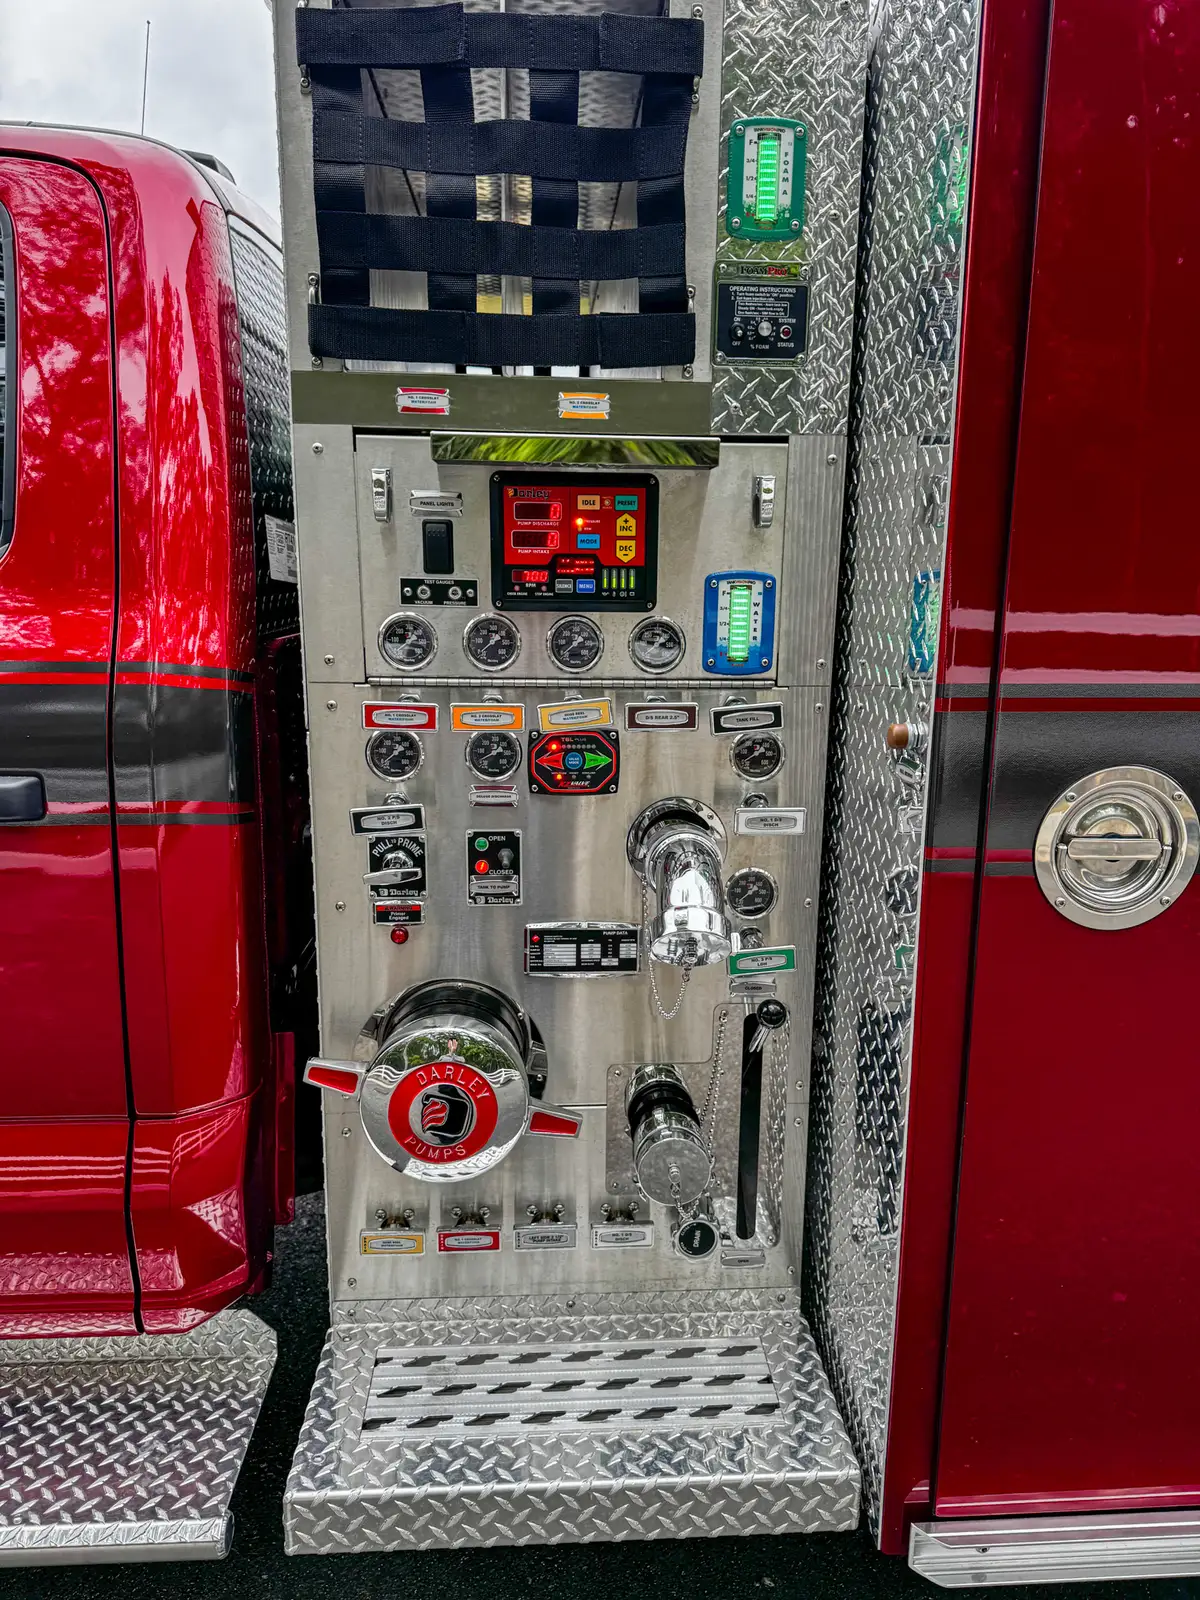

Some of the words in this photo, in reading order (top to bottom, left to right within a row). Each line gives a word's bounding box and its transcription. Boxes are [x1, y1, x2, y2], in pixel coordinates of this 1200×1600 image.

[782, 152, 790, 183] FOAM
[550, 503, 560, 519] 0
[547, 532, 557, 547] 0
[372, 839, 393, 858] PULL
[397, 837, 424, 858] PRIME
[390, 888, 418, 896] Darley
[487, 896, 513, 904] Darley
[416, 1065, 491, 1100] DARLEY
[404, 1135, 466, 1160] PUMPS
[693, 1230, 701, 1248] DRAIN
